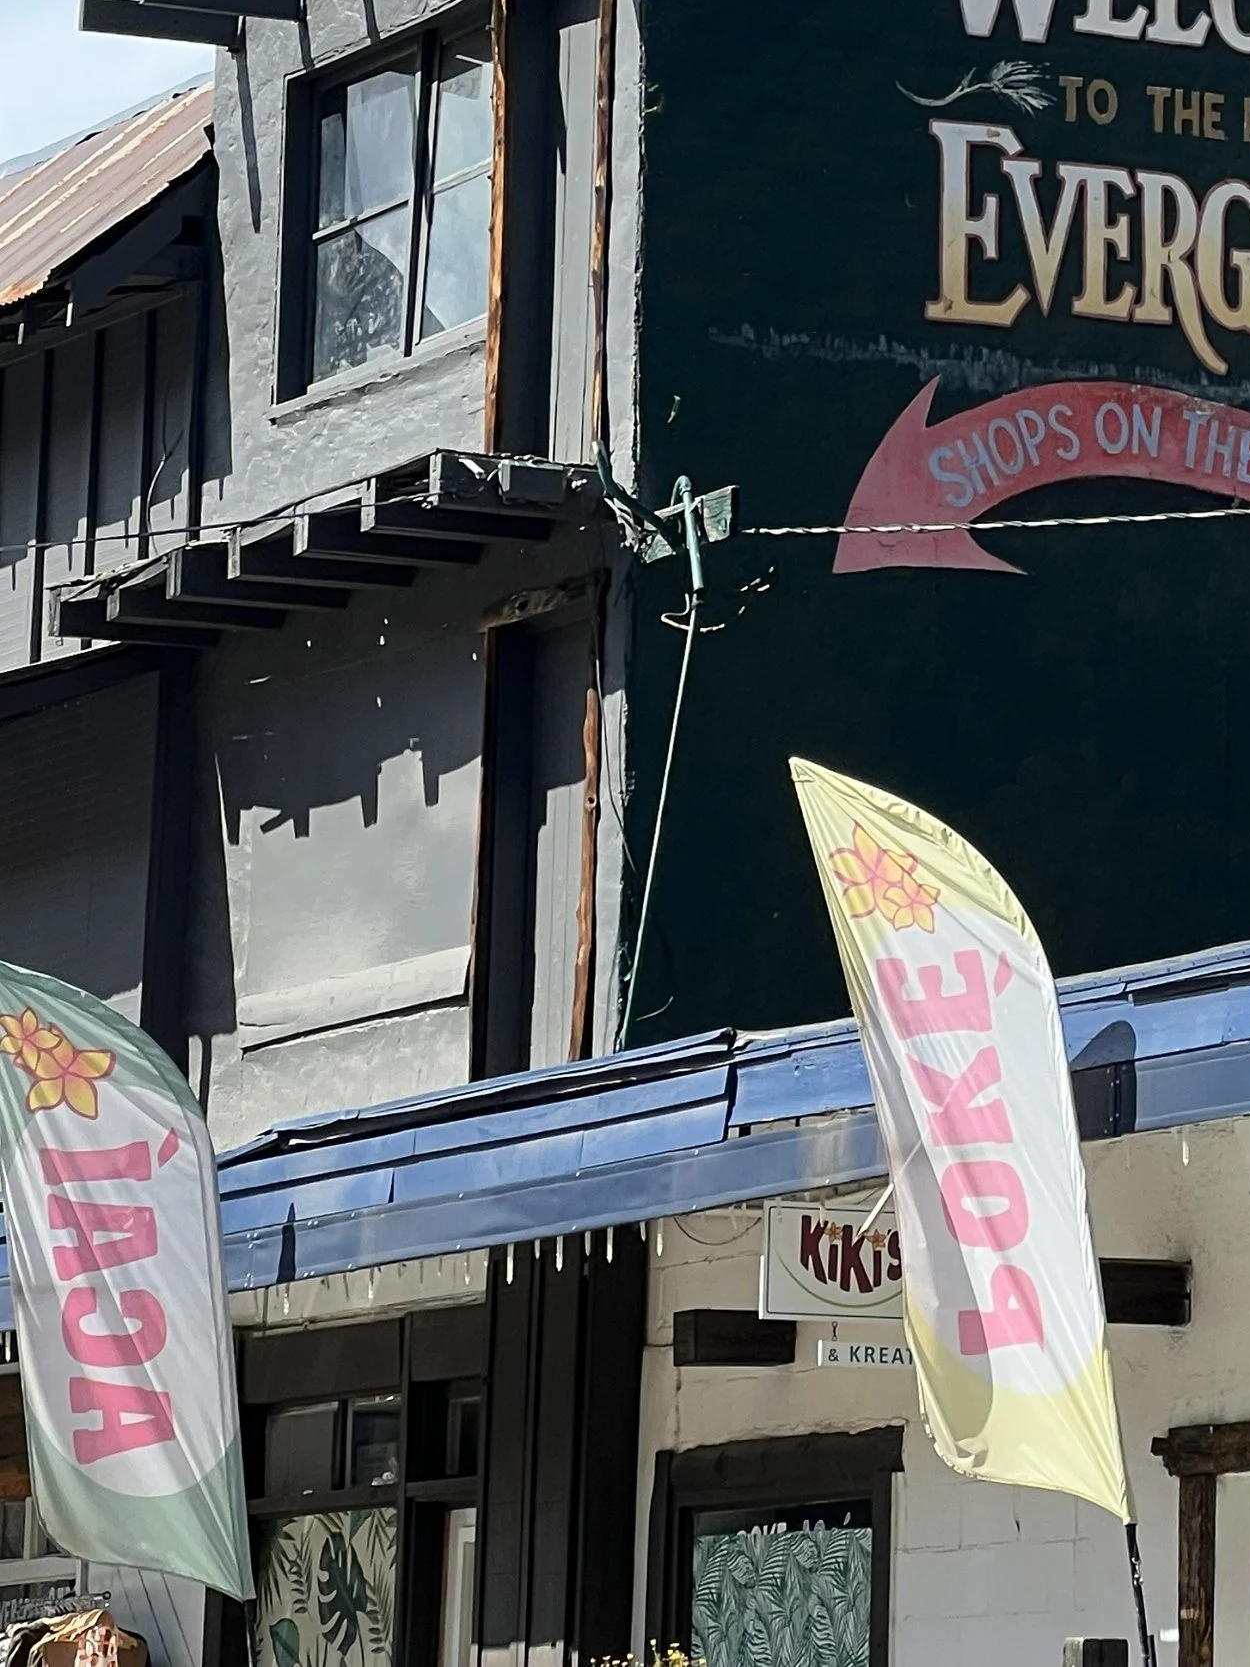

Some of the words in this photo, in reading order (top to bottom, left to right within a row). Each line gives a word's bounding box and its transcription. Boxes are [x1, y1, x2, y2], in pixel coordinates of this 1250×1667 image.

[1058, 75, 1118, 125] TO
[1147, 86, 1225, 140] THE
[928, 404, 1081, 508] SHOPS
[1094, 401, 1162, 458] ON
[828, 1348, 840, 1362] &
